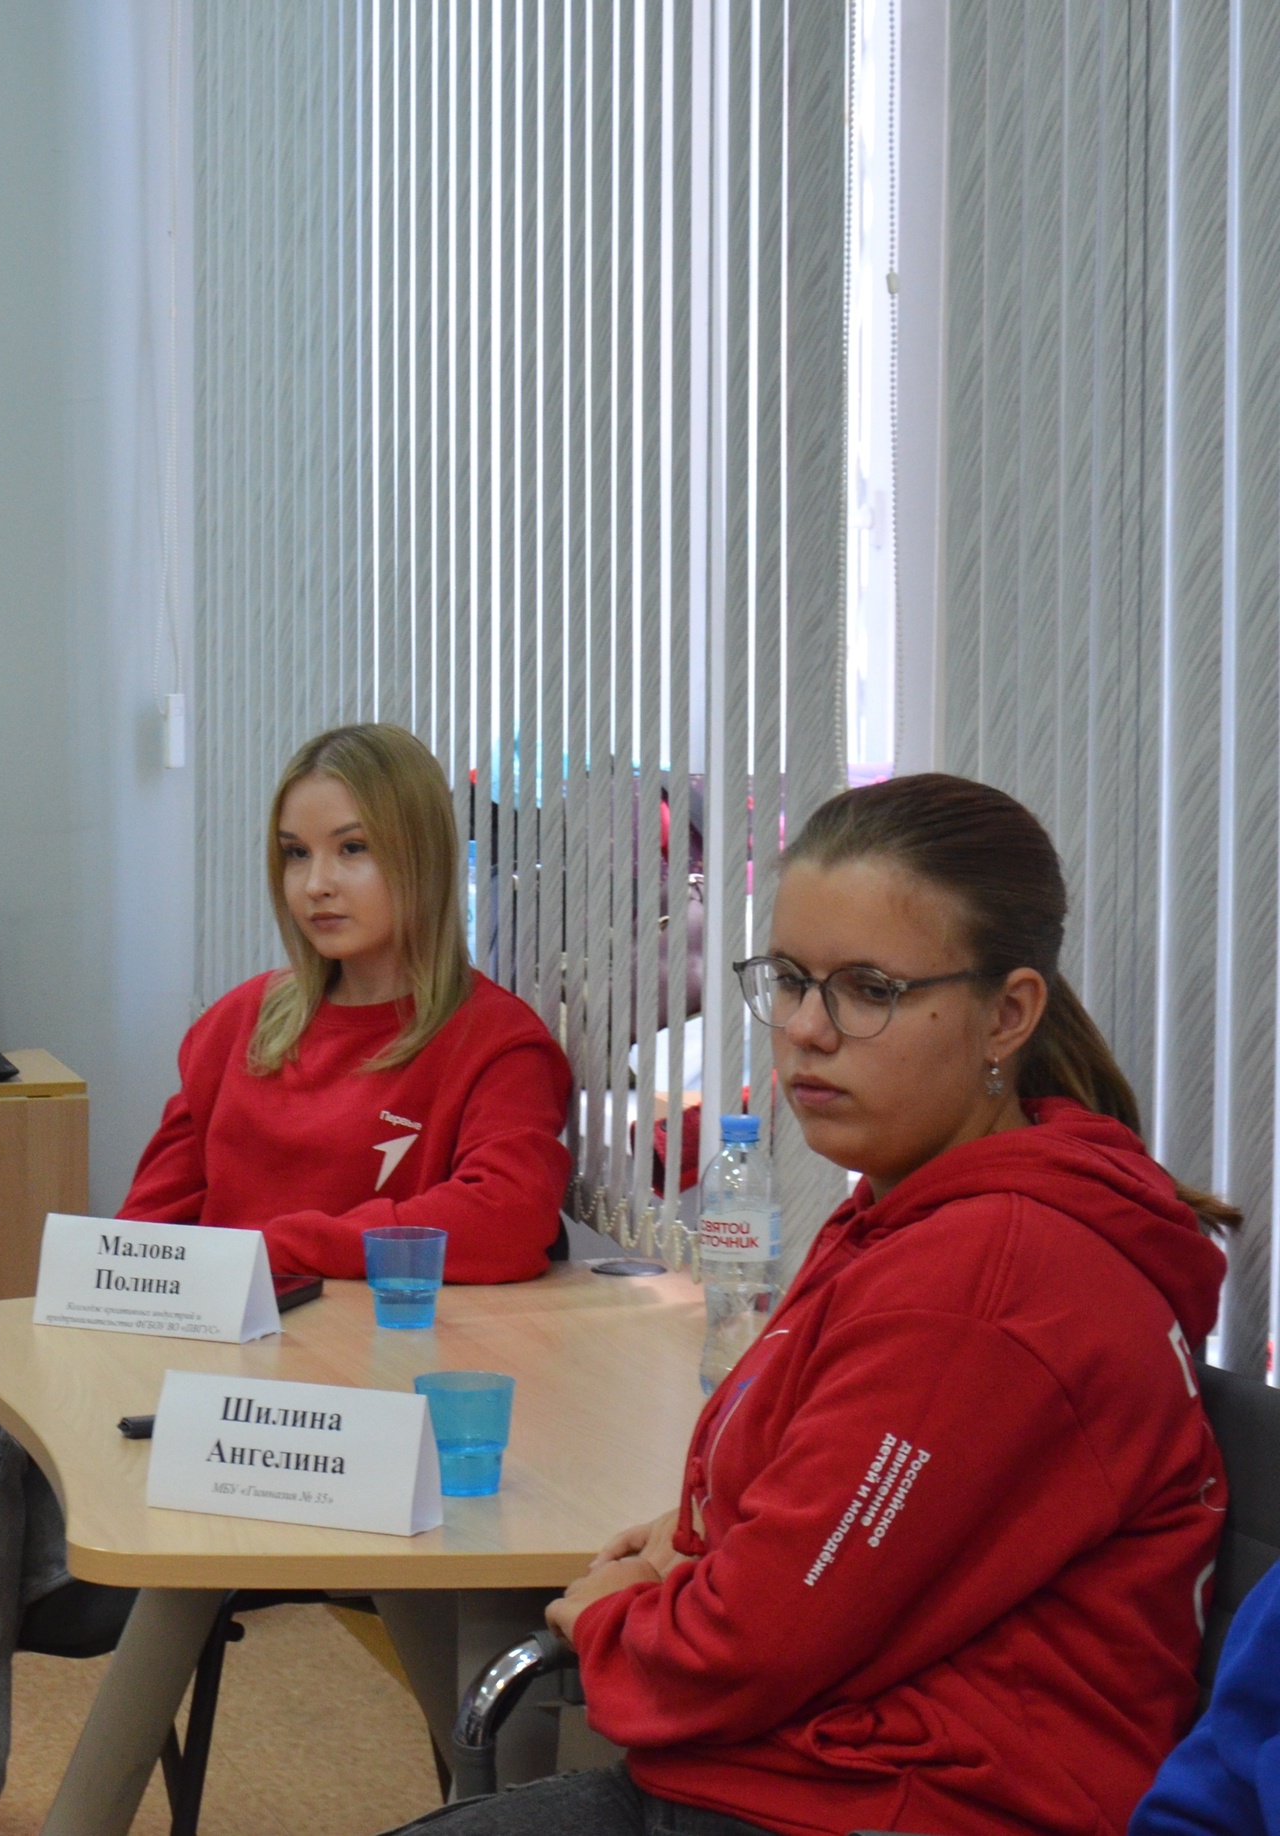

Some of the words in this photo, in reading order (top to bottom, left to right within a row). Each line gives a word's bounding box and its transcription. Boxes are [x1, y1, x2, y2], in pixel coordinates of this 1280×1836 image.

[98, 1234, 186, 1261] Малова
[94, 1268, 181, 1295] Полина
[220, 1396, 342, 1431] Шилина
[206, 1439, 346, 1475] Ангелина
[864, 1432, 897, 1483] детей
[856, 1484, 871, 1498] и
[860, 1440, 912, 1527] движение
[867, 1449, 931, 1548] Российское
[803, 1499, 863, 1587] молодёжи
